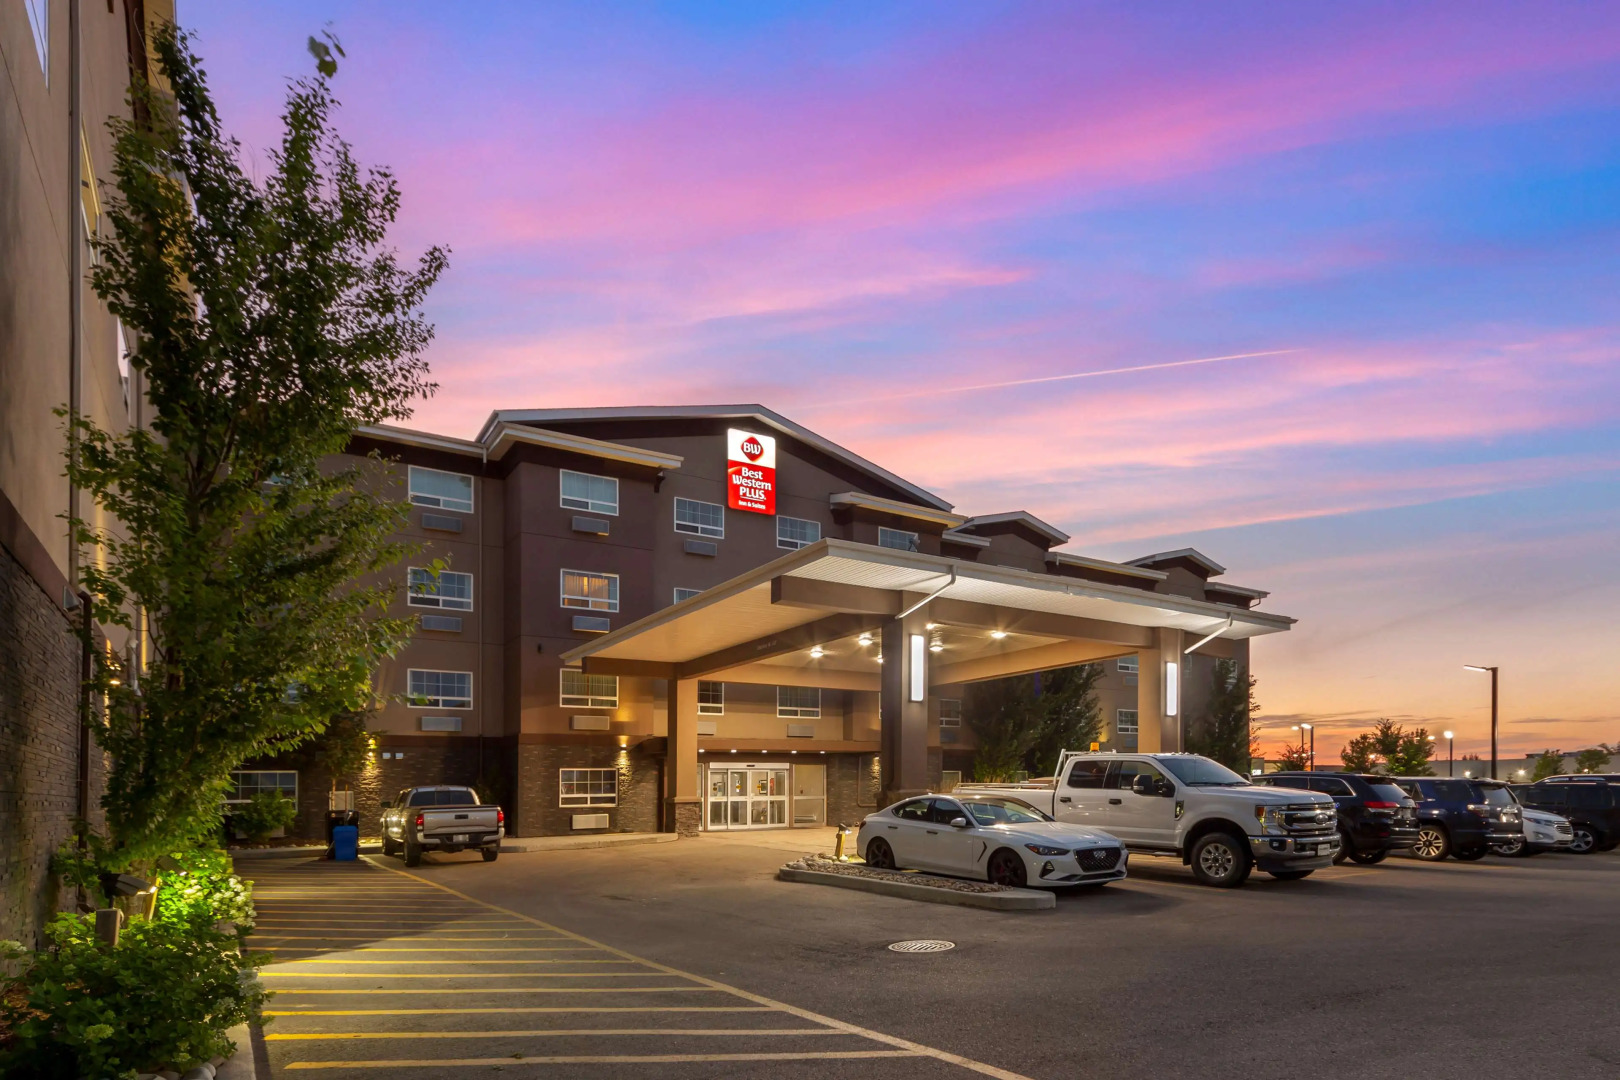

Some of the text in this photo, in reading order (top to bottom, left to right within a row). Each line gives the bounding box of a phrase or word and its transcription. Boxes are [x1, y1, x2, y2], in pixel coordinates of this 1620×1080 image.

[743, 442, 761, 454] BW
[742, 467, 763, 480] Best
[732, 474, 772, 490] Western
